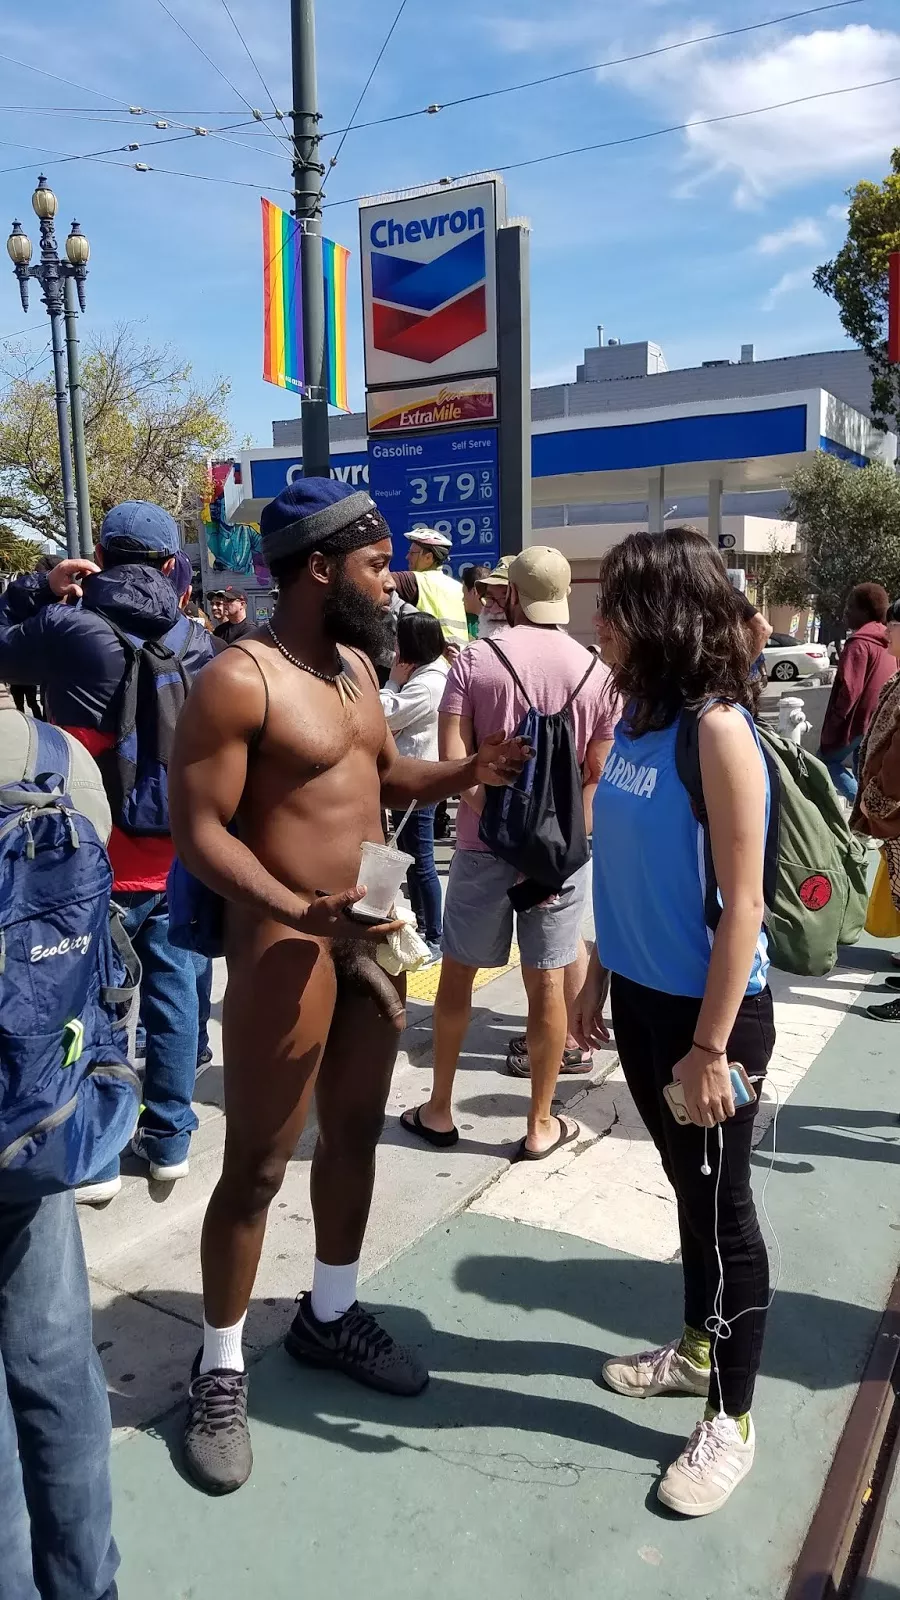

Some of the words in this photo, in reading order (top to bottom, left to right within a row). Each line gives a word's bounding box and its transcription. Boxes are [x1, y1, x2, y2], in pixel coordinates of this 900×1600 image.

[370, 206, 485, 248] Chevron
[400, 403, 462, 426] ExtraMile
[373, 444, 423, 458] Gasoline
[452, 441, 467, 451] Self
[469, 439, 492, 449] Serve
[375, 489, 402, 498] Regular
[411, 518, 476, 545] 89
[30, 932, 92, 962] EcoCity
